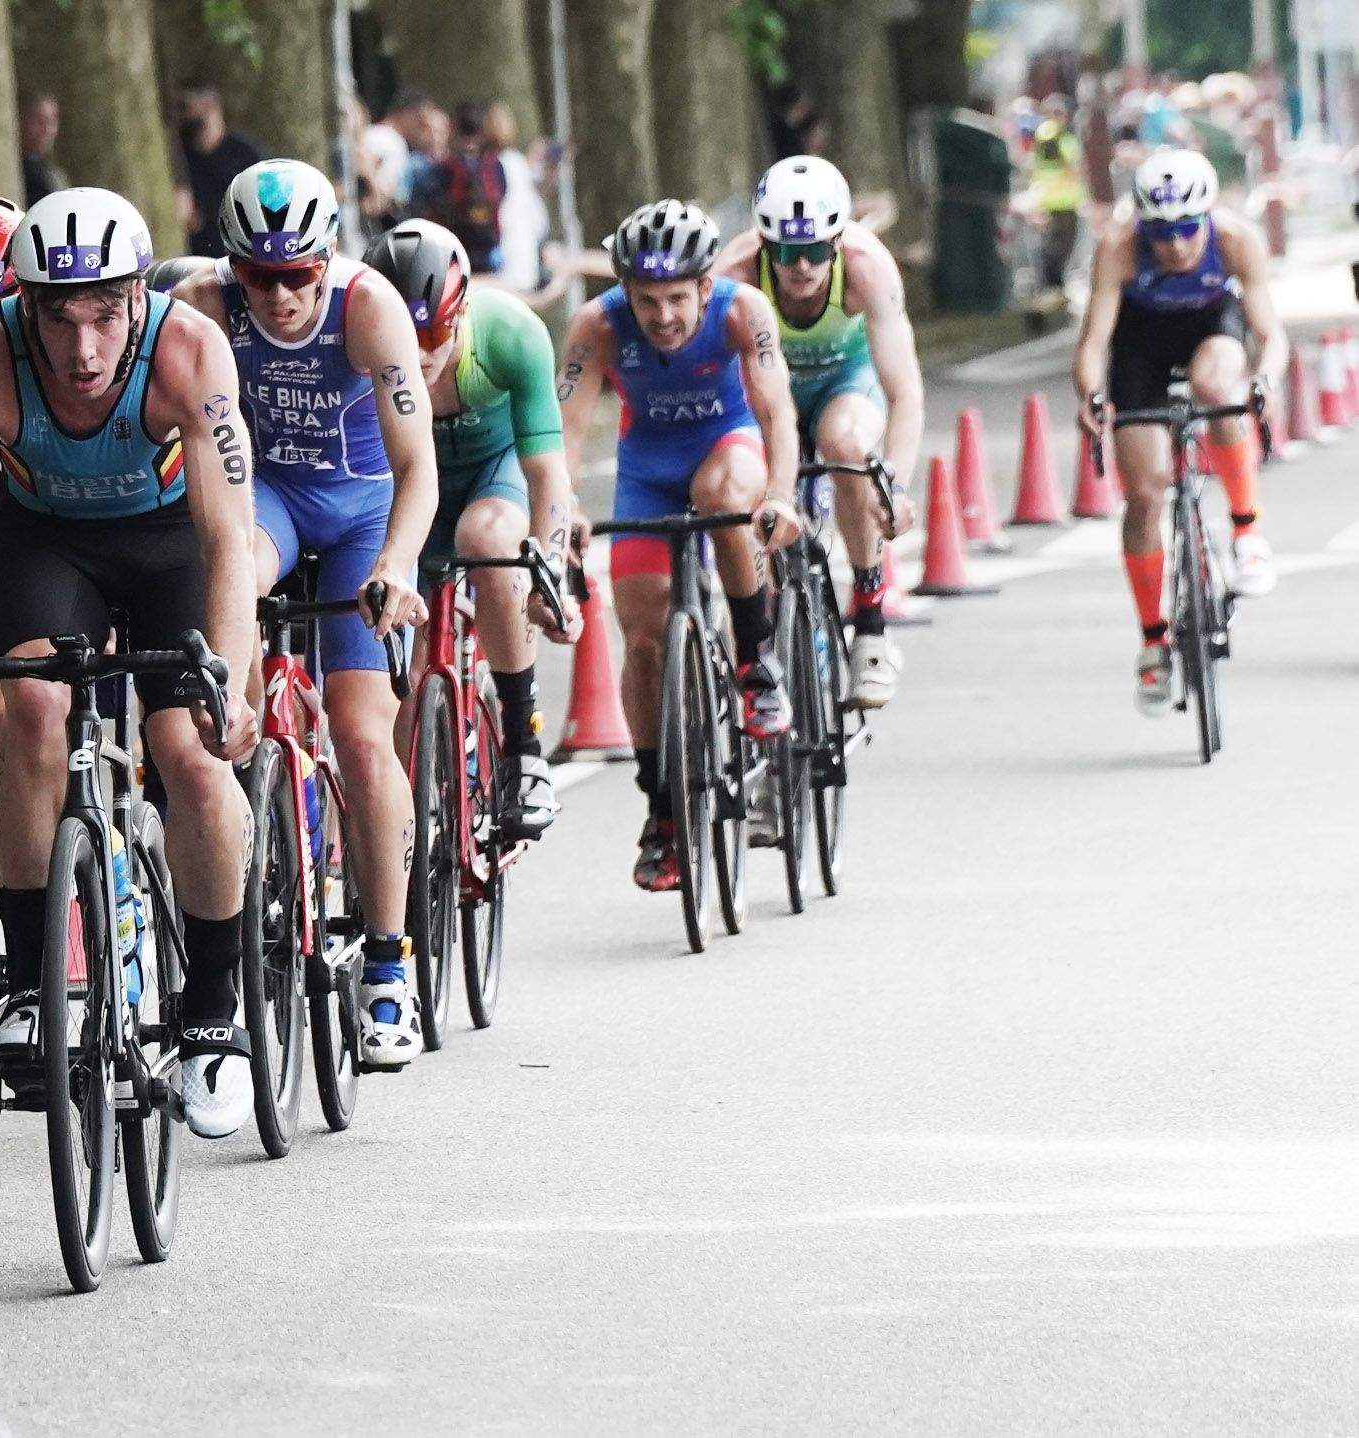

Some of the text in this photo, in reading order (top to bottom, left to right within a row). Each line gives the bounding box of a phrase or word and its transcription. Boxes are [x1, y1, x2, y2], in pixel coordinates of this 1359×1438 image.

[263, 239, 273, 253] 6
[56, 253, 74, 269] 29
[246, 381, 343, 411] LE BIHAN
[392, 389, 417, 416] 6
[269, 407, 322, 428] FRA
[648, 398, 725, 424] CAM
[50, 482, 146, 500] BEL
